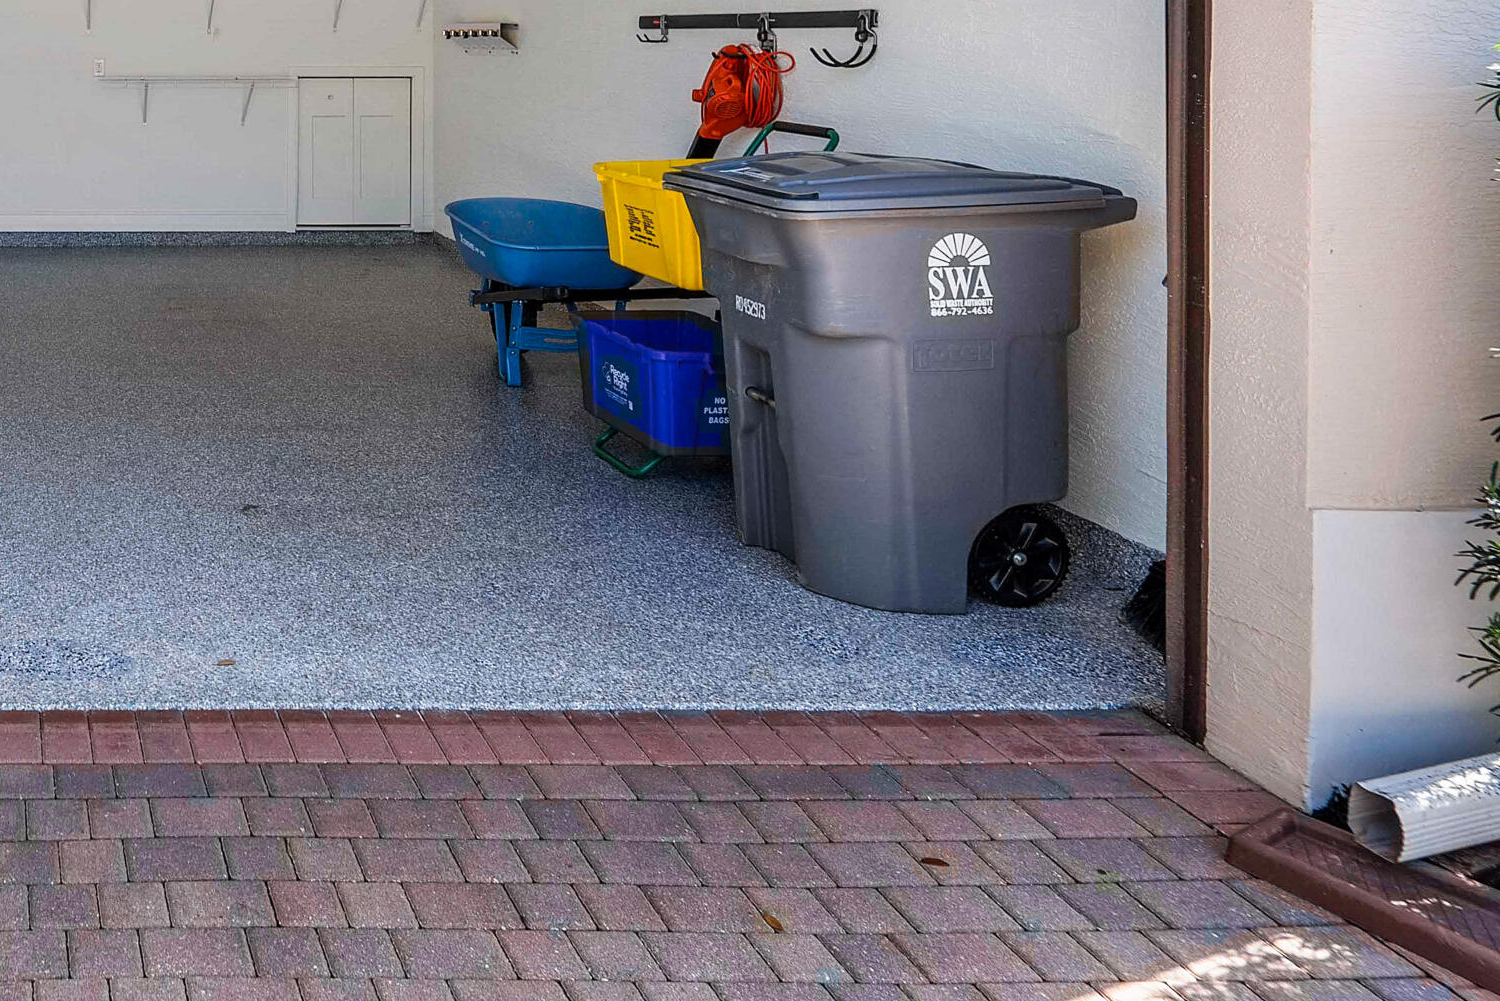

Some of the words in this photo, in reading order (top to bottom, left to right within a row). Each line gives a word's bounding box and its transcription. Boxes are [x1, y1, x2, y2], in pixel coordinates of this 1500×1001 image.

[927, 266, 994, 300] SWA
[946, 299, 963, 308] WASTE
[930, 306, 994, 316] 866-792-4636
[714, 397, 726, 405] NO
[703, 407, 730, 415] PLAST
[708, 416, 731, 424] BAGS
